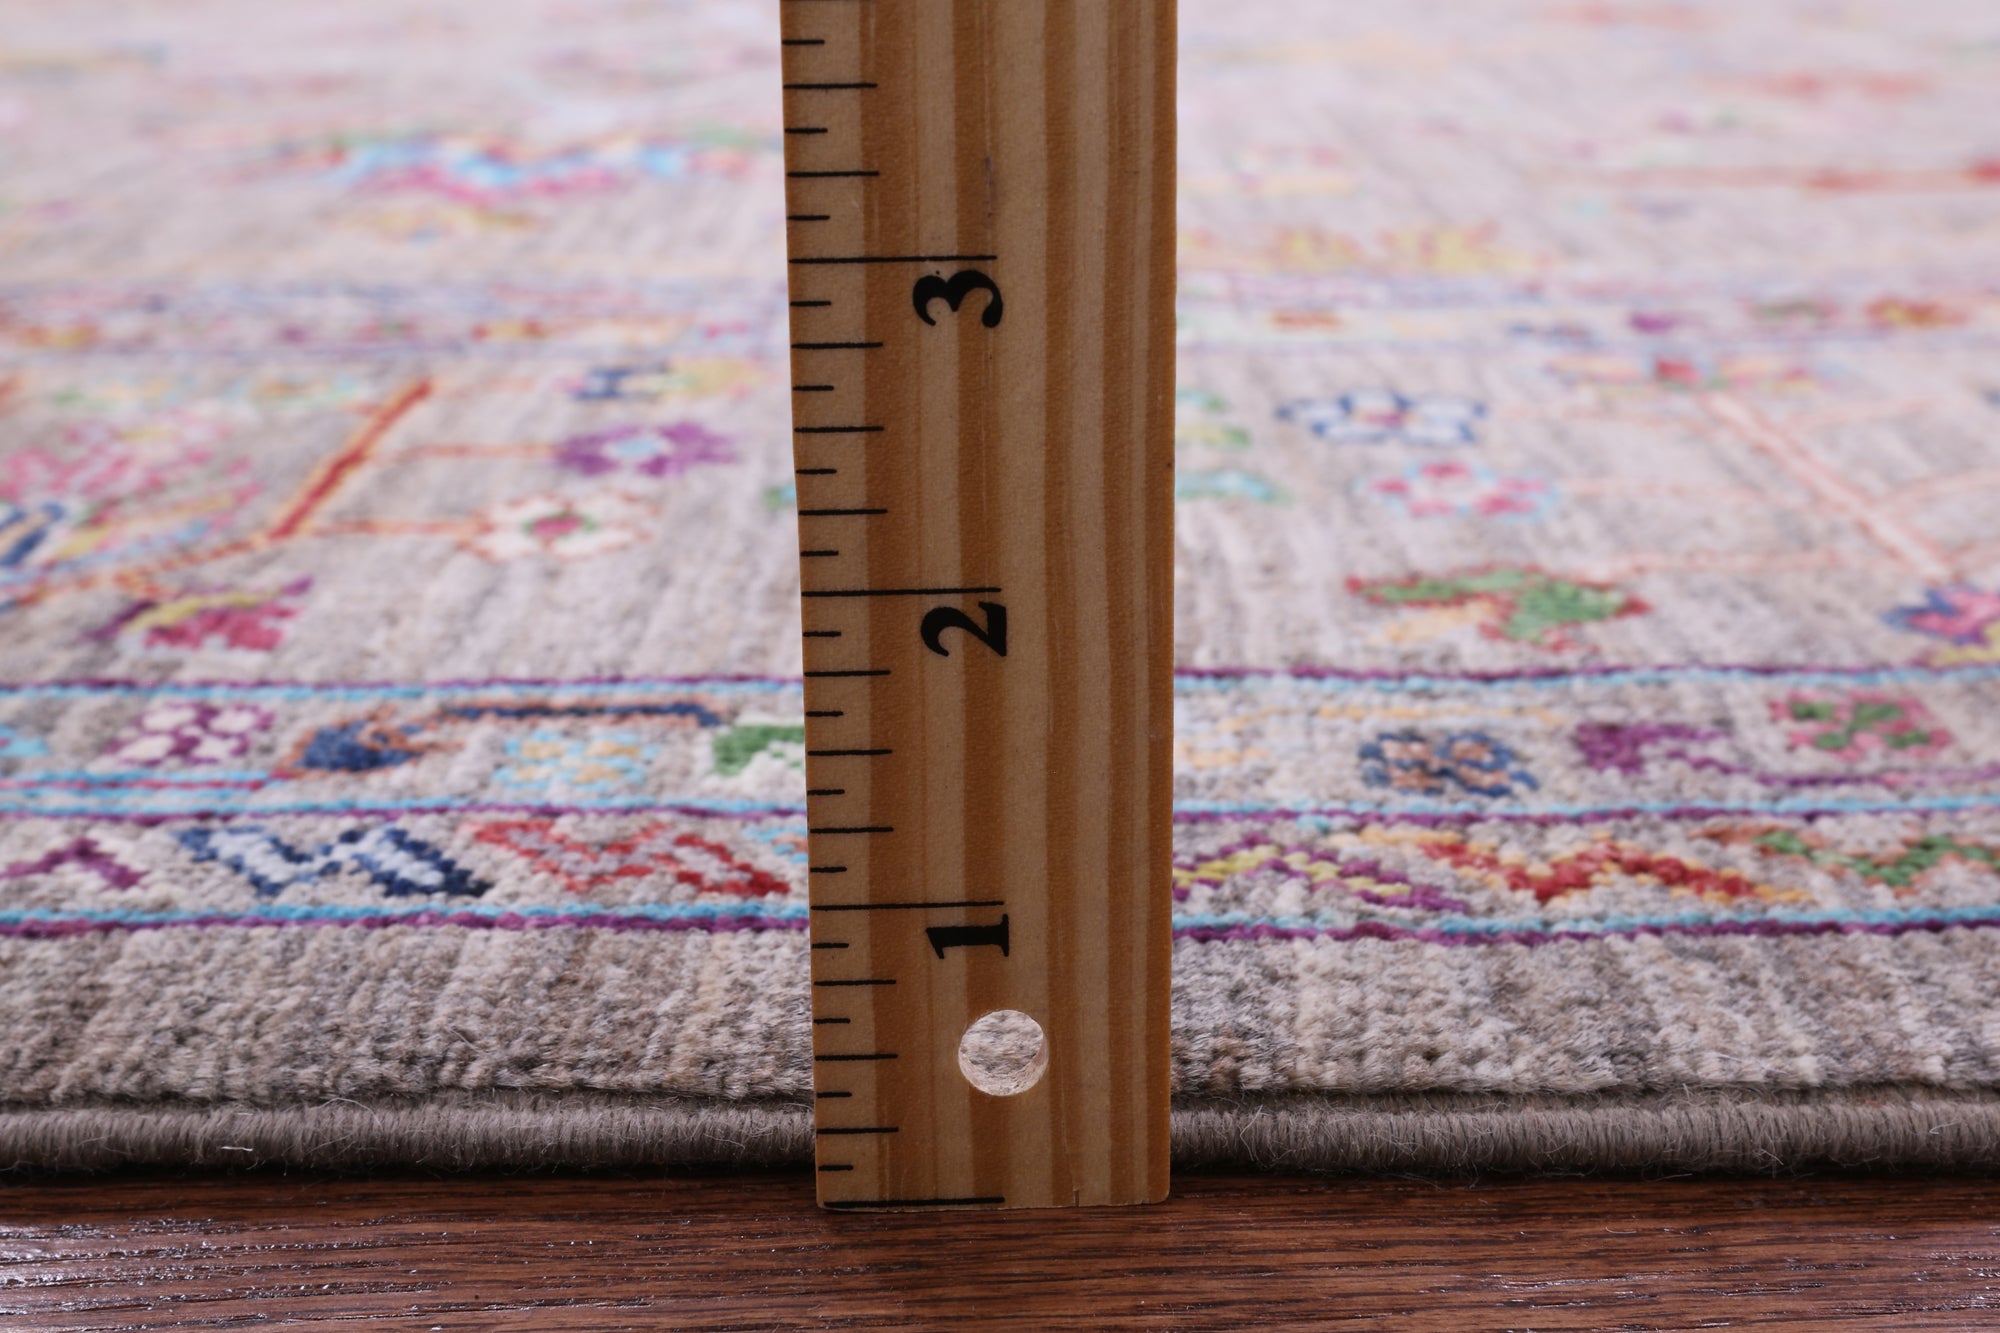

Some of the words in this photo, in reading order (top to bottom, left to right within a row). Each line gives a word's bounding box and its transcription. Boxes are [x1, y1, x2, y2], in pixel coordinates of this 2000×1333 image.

[912, 269, 1004, 329] 3
[920, 601, 1008, 658] 2
[925, 913, 1010, 960] 1
